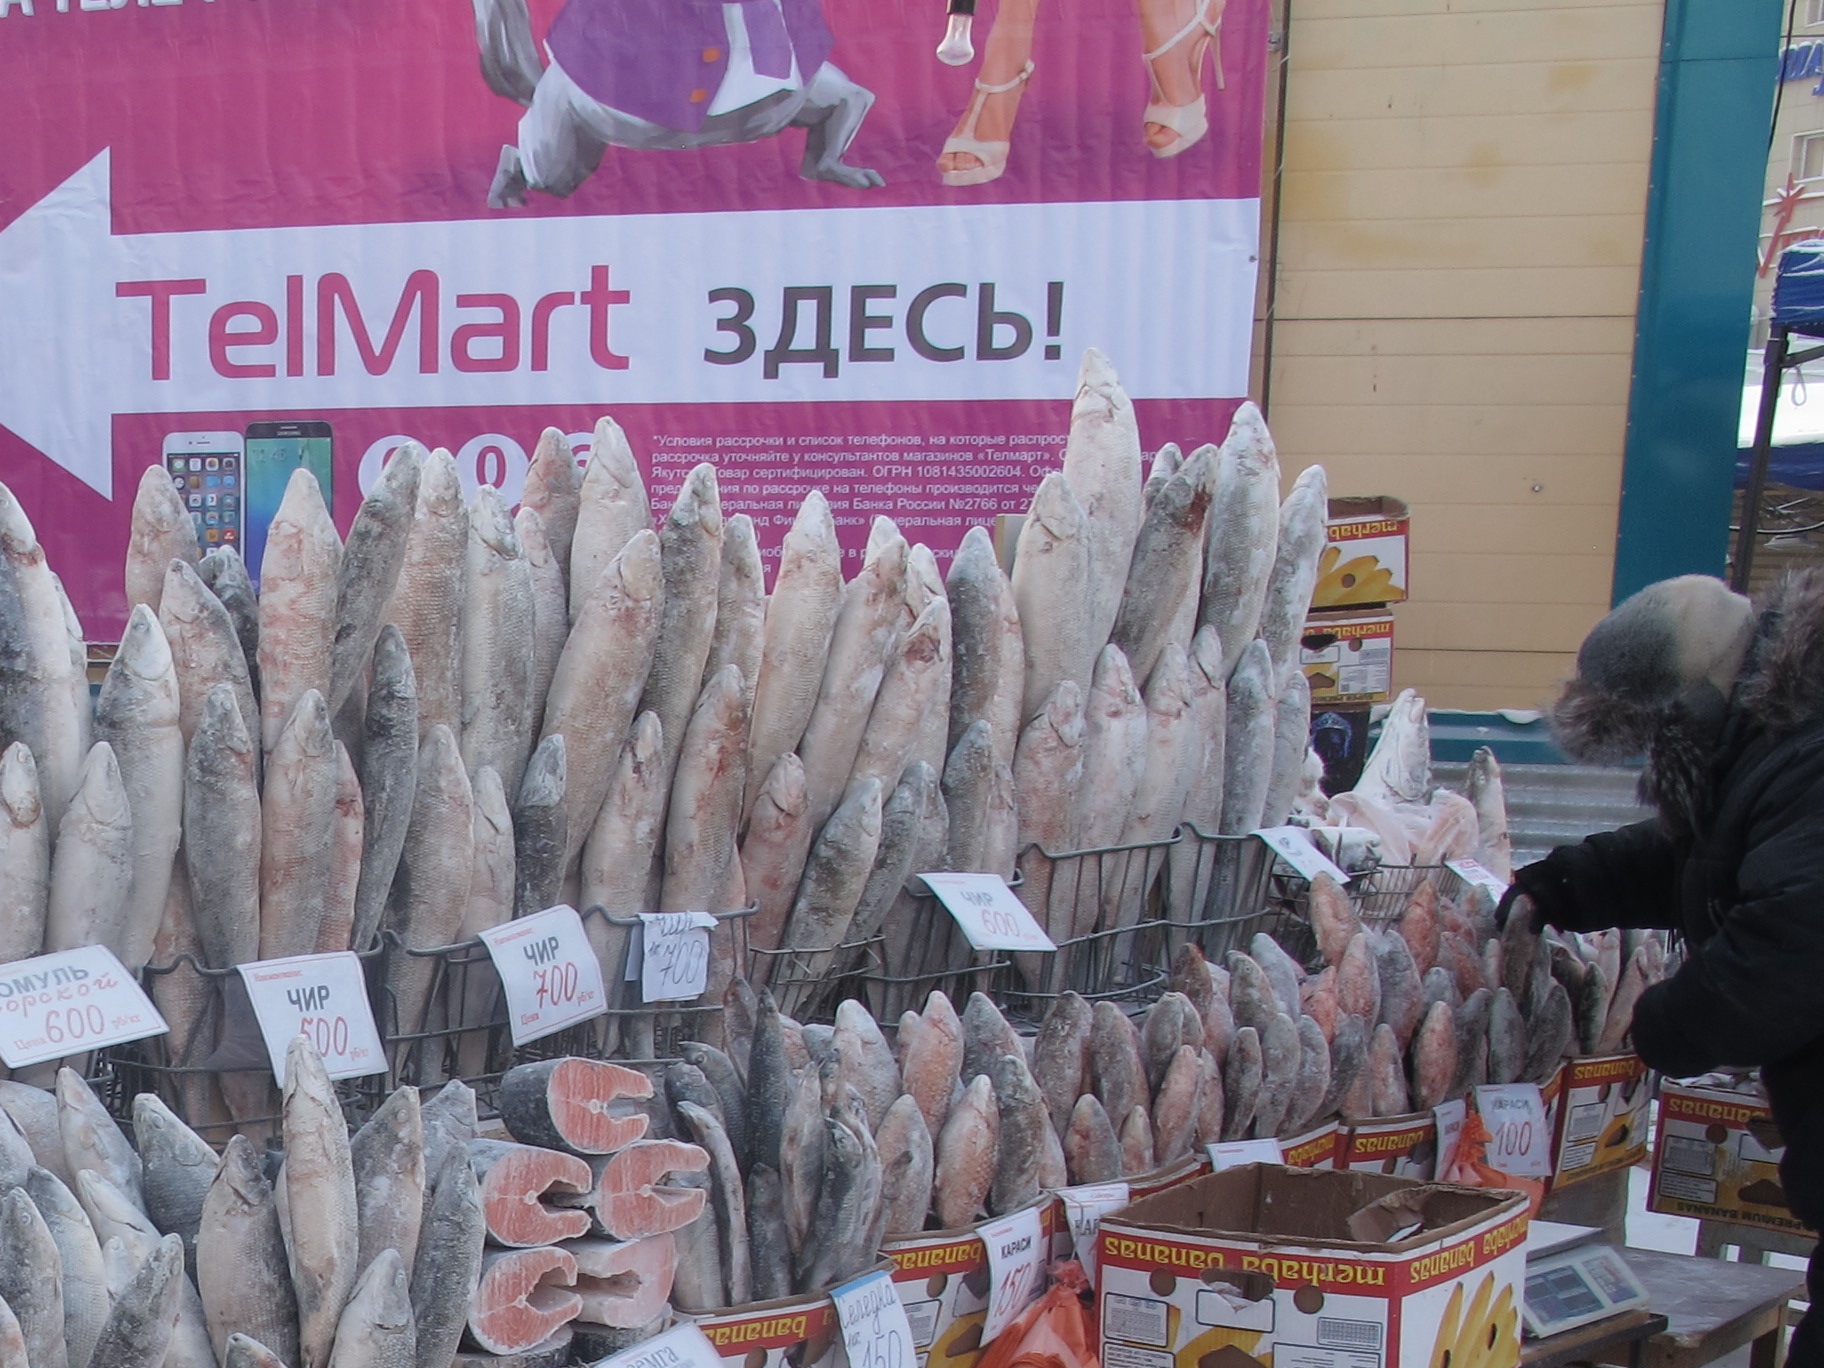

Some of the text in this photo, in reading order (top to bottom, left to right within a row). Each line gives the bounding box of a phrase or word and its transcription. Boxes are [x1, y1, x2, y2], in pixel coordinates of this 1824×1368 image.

[115, 265, 1065, 381] TelMart ЗДЕСЬ!
[716, 437, 784, 449] рассрочки
[787, 437, 795, 446] и
[799, 437, 844, 448] список
[848, 434, 926, 447] телефонов,
[929, 436, 946, 445] на
[950, 435, 1006, 447] которые
[651, 453, 719, 465] рассрочка
[723, 451, 789, 464] уточняйте
[792, 453, 800, 464] у
[804, 452, 899, 464] консультантов
[903, 451, 974, 462] магазинов
[872, 466, 911, 477] ОГРН
[836, 485, 850, 493] на
[853, 482, 923, 495] телефоны
[926, 483, 1019, 496] производится
[853, 498, 1015, 511] Банка России №2766 от
[1329, 520, 1399, 538] merhab
[960, 891, 993, 907] ЧИР
[981, 909, 1020, 937] 600
[522, 936, 560, 966] ЧИР
[286, 985, 330, 1012] ЧИР
[533, 962, 578, 1009] 700
[45, 1004, 105, 1044] 600
[300, 1016, 348, 1058] 500
[1575, 1060, 1636, 1081] bananas
[1496, 1121, 1532, 1156] 100
[1000, 1236, 1032, 1260] КАРАСИ
[1104, 1236, 1386, 1287] merhaba bananas
[1410, 1240, 1475, 1283] bananas
